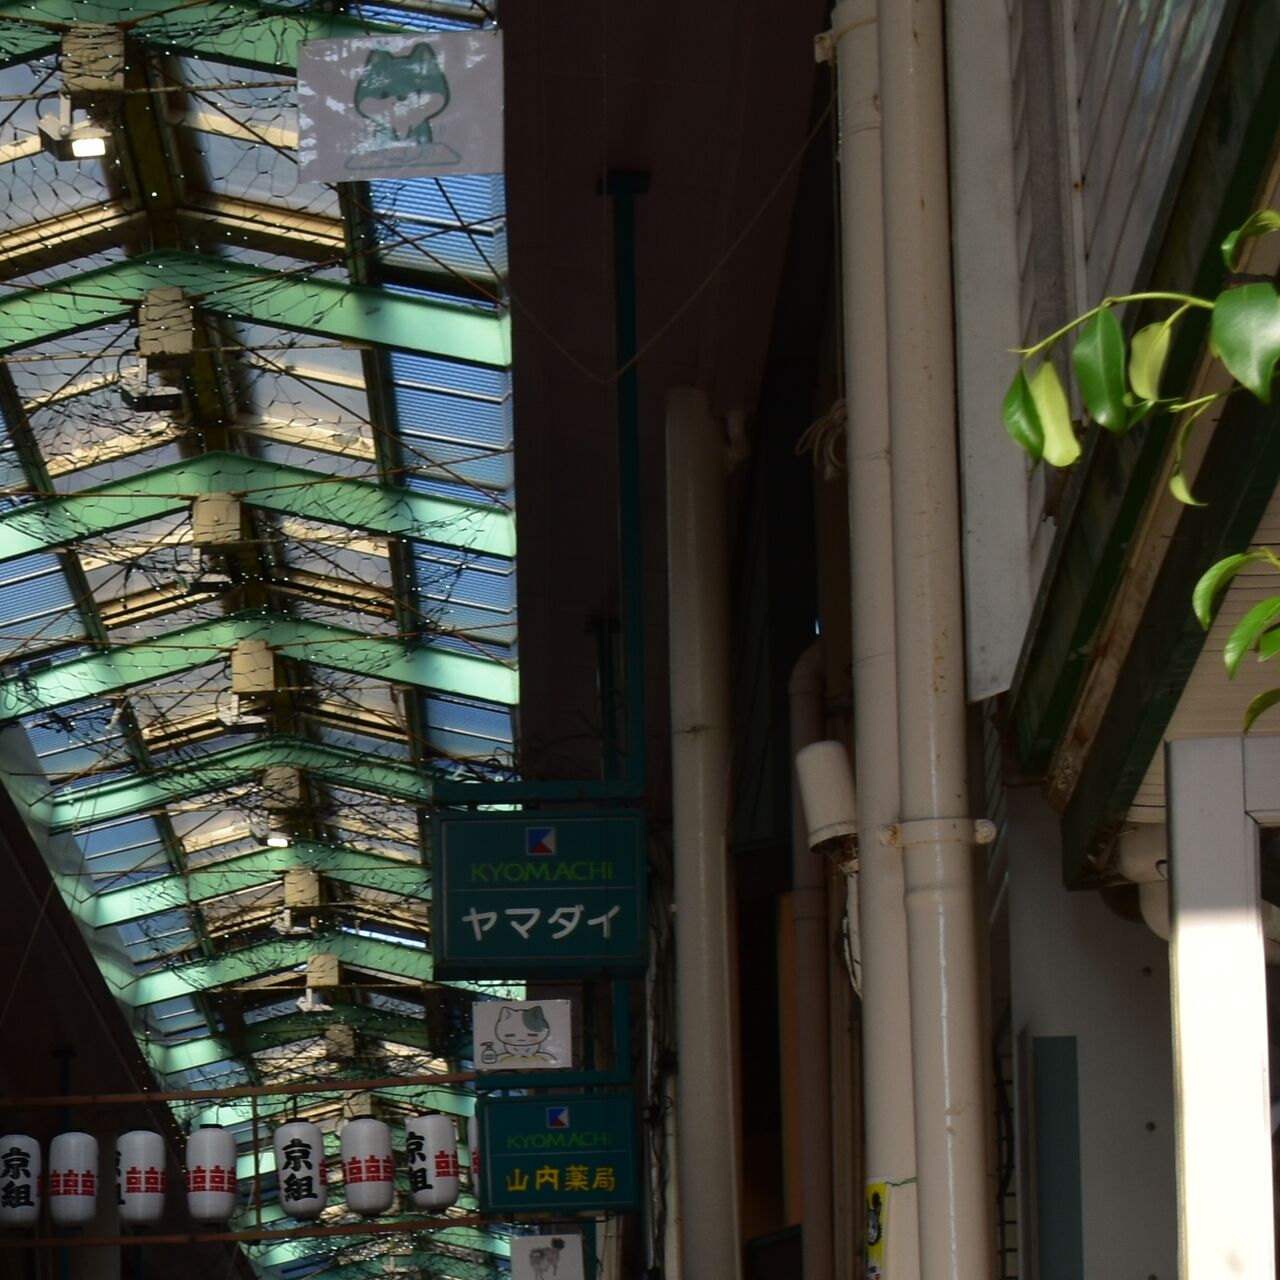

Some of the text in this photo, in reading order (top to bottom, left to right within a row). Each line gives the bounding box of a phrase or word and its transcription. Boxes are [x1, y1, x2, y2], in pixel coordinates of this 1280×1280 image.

[471, 861, 615, 882] KYOMACHI
[461, 905, 622, 942] ヤマダイ
[506, 1130, 612, 1149] KYOMACHI
[0, 1147, 34, 1208] 京組
[281, 1138, 318, 1202] 京組
[506, 1164, 616, 1193] 山内薬局
